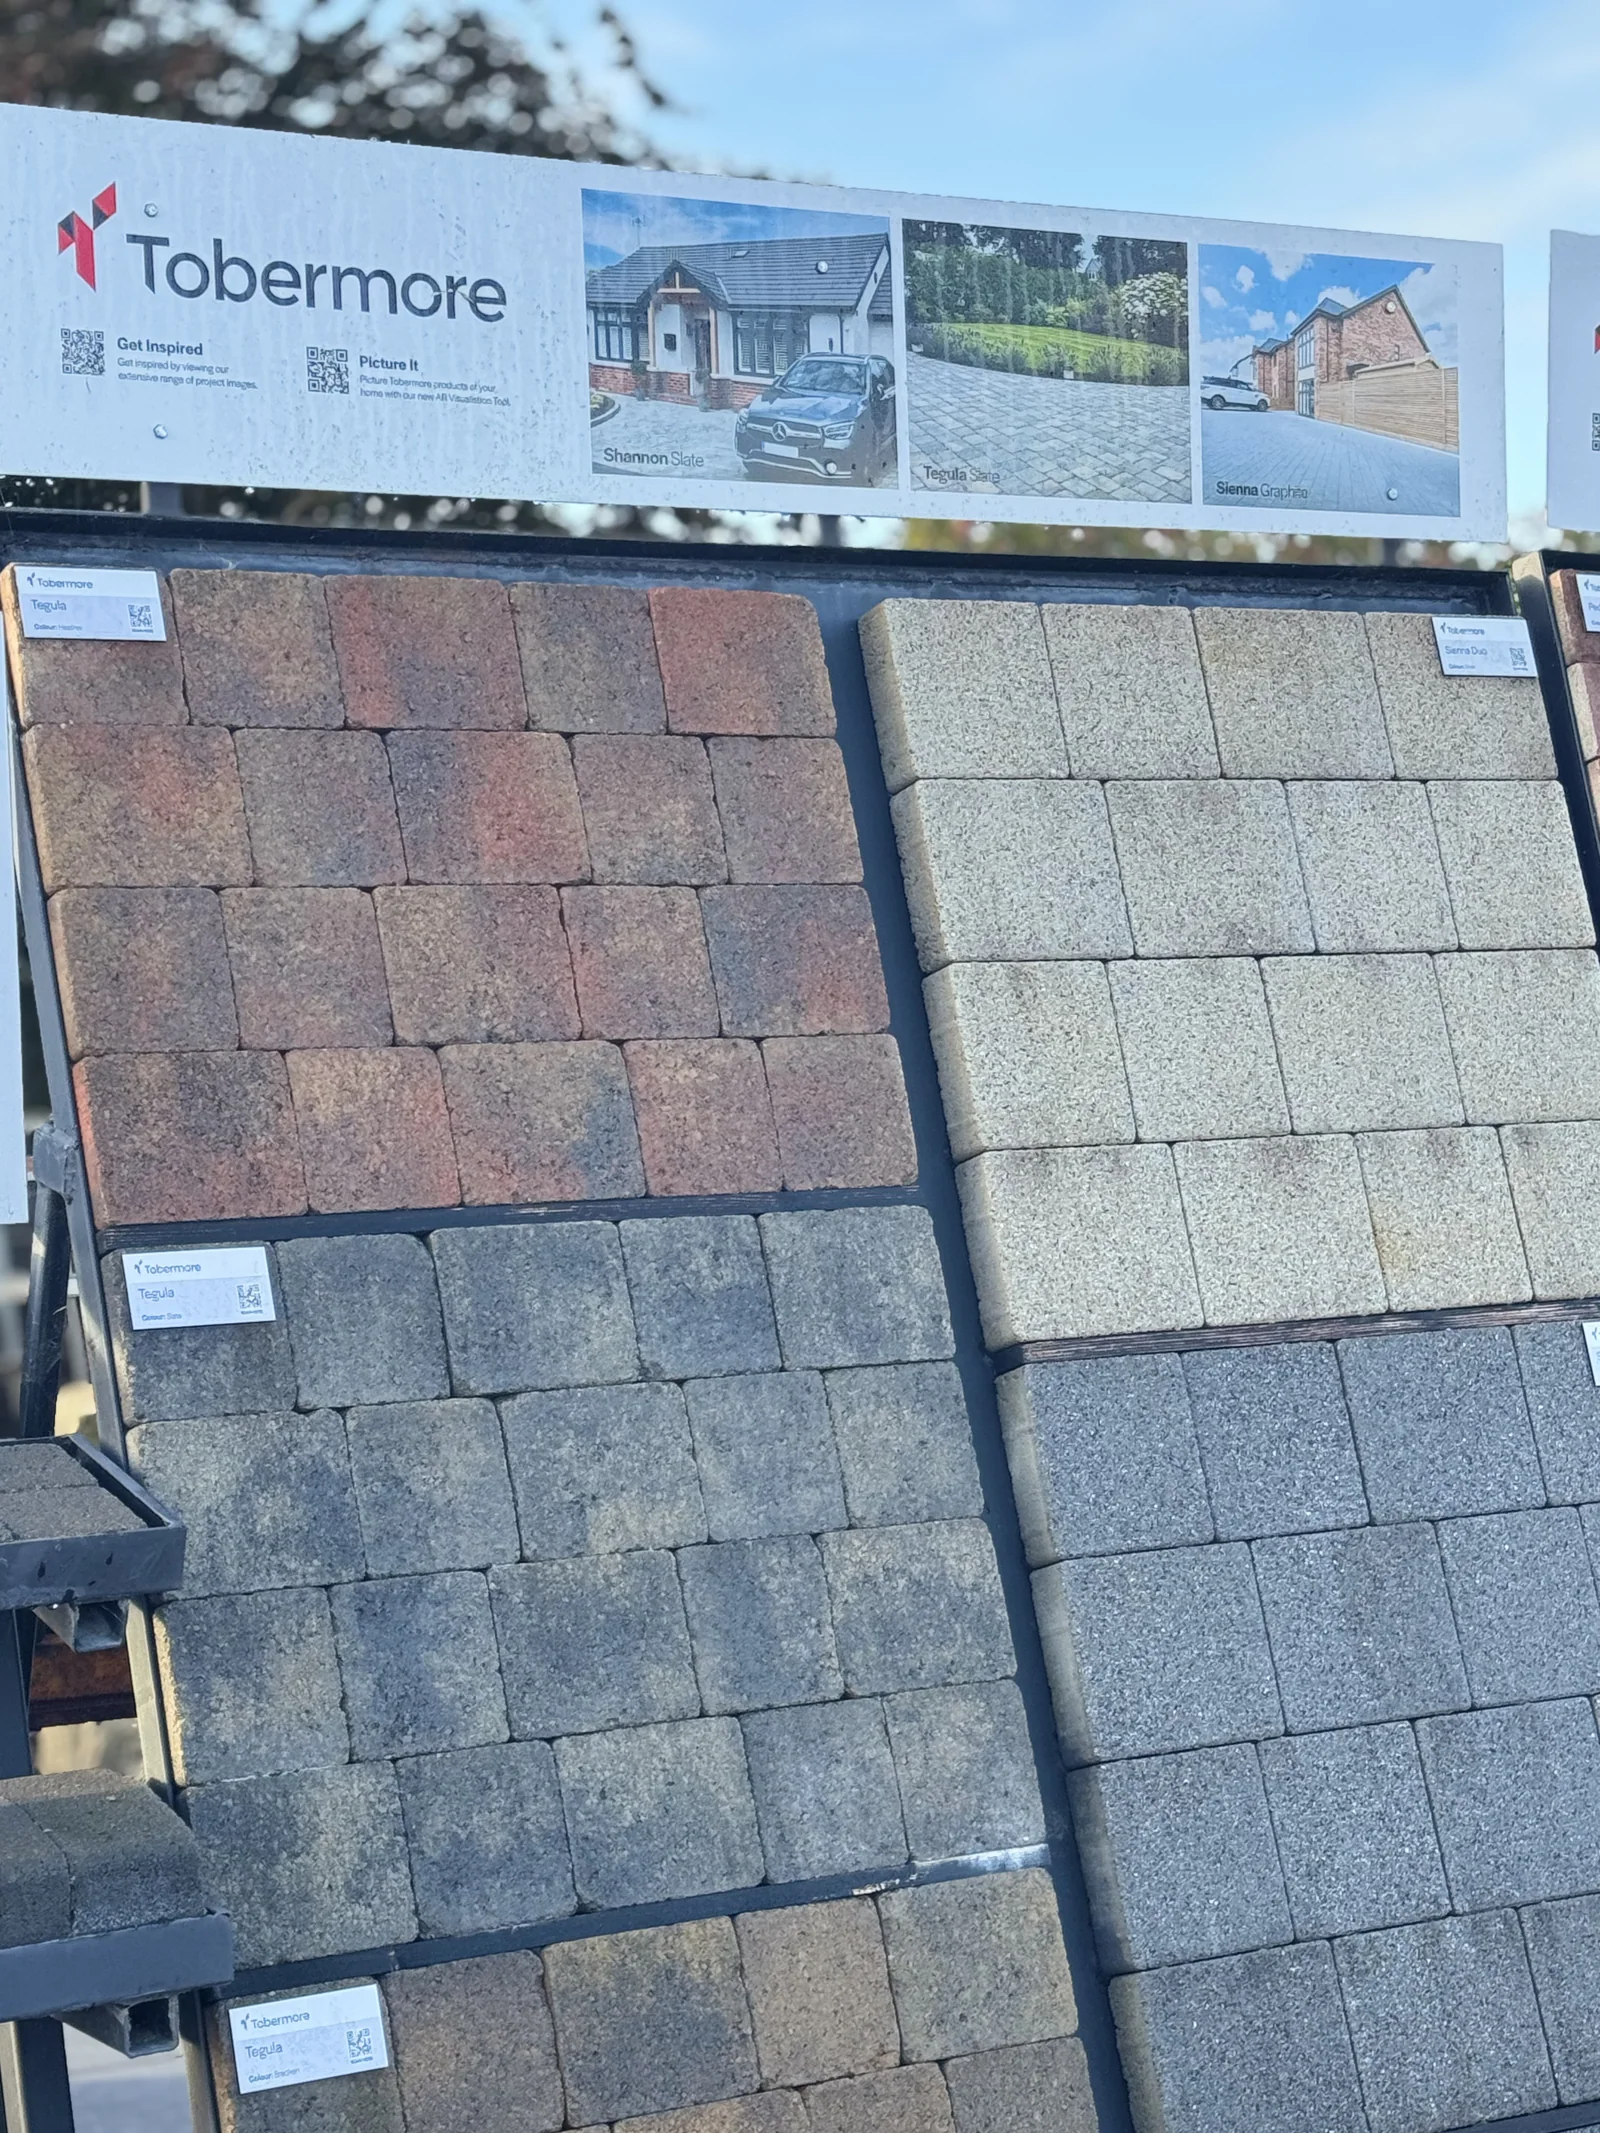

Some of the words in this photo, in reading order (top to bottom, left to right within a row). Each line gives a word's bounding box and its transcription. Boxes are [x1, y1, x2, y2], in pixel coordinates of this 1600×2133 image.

[126, 233, 507, 322] Tobermore
[117, 337, 143, 352] Get
[146, 339, 203, 356] Inspired
[117, 357, 134, 367] Get
[135, 358, 169, 370] inspired
[170, 361, 181, 372] by
[182, 363, 214, 375] viewing
[215, 365, 229, 374] our
[359, 355, 406, 371] Picture
[409, 359, 419, 371] It
[118, 372, 158, 383] extensive
[160, 375, 183, 386] range
[185, 376, 194, 385] of
[195, 377, 225, 388] project
[360, 375, 388, 386] Picture
[390, 376, 432, 389] Tobermore
[433, 380, 468, 391] products
[360, 388, 383, 398] home
[385, 389, 401, 399] with
[402, 391, 416, 400] our
[417, 392, 434, 401] new
[603, 447, 669, 466] Shannon
[671, 451, 704, 468] Slate
[923, 465, 967, 484] Tegula
[1216, 481, 1258, 496] Sienna
[37, 577, 94, 589] Tobermore
[31, 599, 67, 612] Tegula
[144, 1263, 201, 1275] Tobermore
[138, 1287, 175, 1302] Tegula
[250, 2012, 310, 2029] Tobermore
[245, 2042, 283, 2060] Tegula
